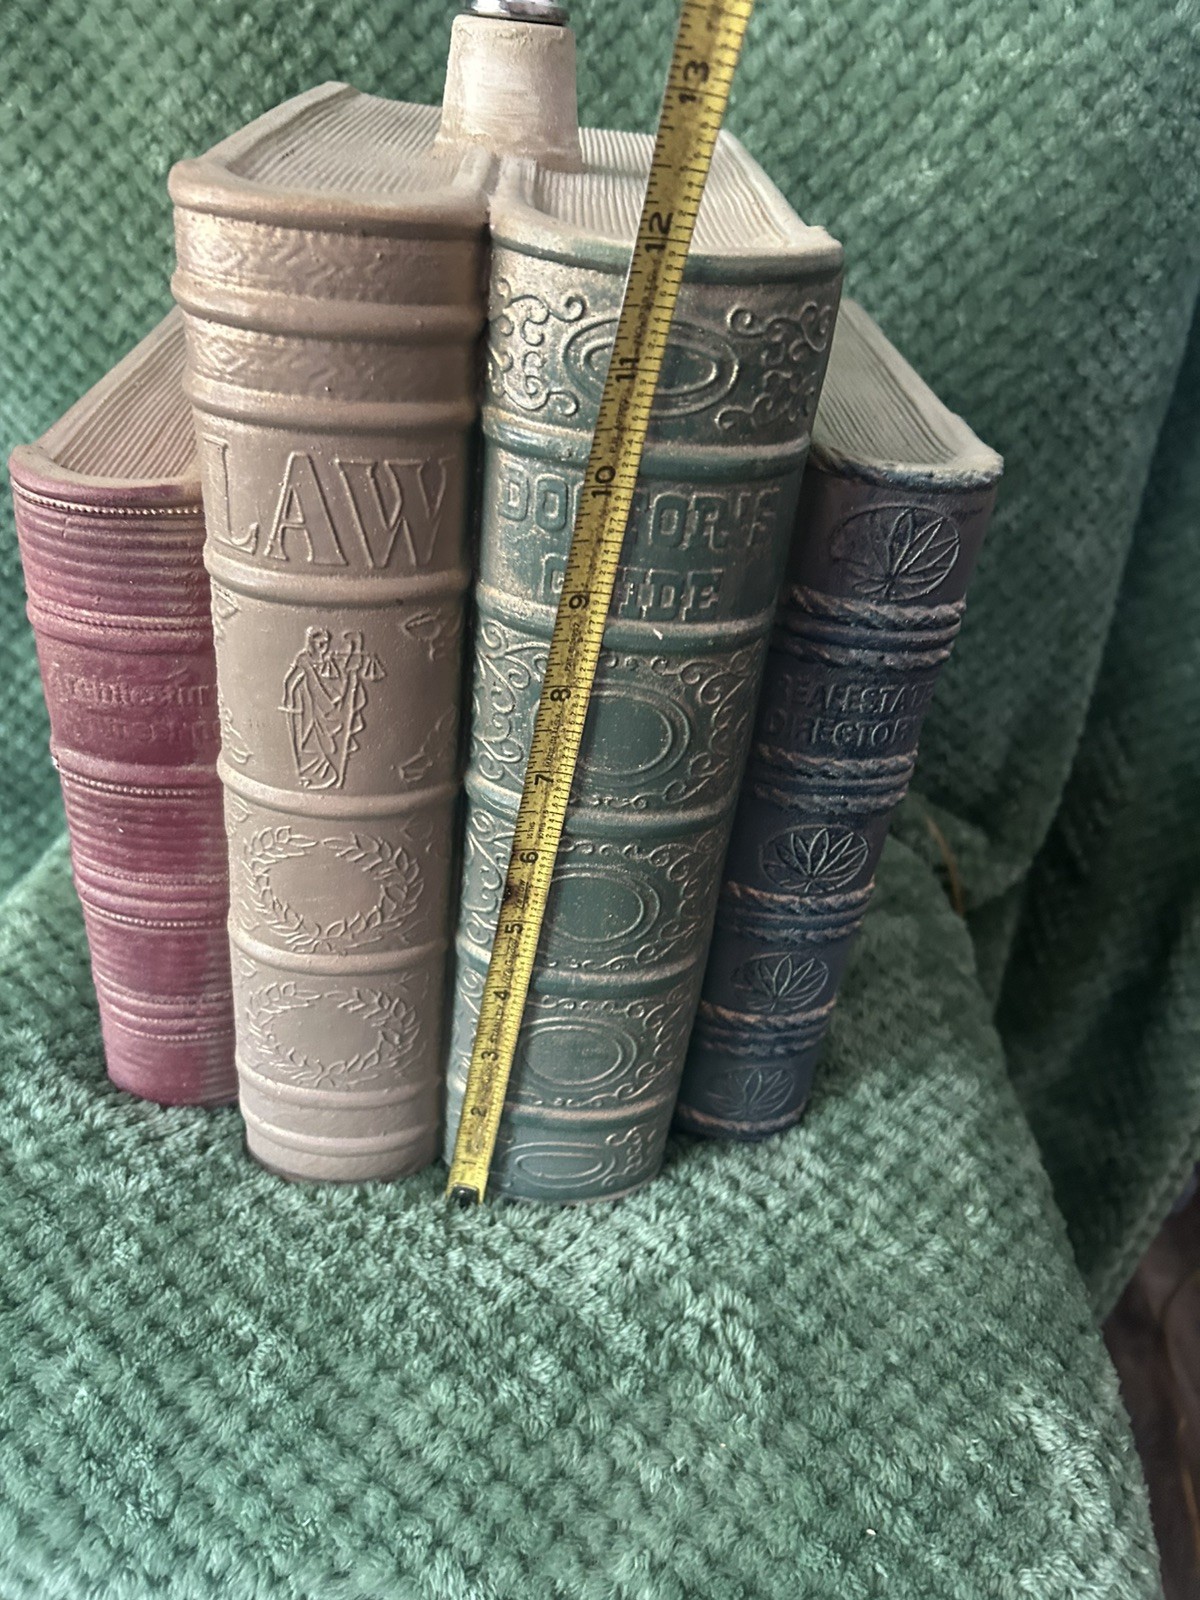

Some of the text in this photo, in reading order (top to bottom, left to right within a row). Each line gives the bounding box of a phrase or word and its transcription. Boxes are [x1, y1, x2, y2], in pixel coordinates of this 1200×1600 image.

[677, 60, 709, 104] 13
[644, 212, 673, 252] 12
[615, 357, 639, 383] 11
[591, 465, 616, 498] 10
[201, 432, 456, 568] LAW
[541, 553, 725, 621] GIDE
[569, 591, 589, 609] 9
[550, 685, 571, 702] 8
[534, 774, 553, 785] 7
[519, 849, 538, 864] 6
[504, 923, 523, 935] 5
[493, 990, 510, 1001] 4
[481, 1050, 499, 1061] 3
[470, 1106, 487, 1117] 2
